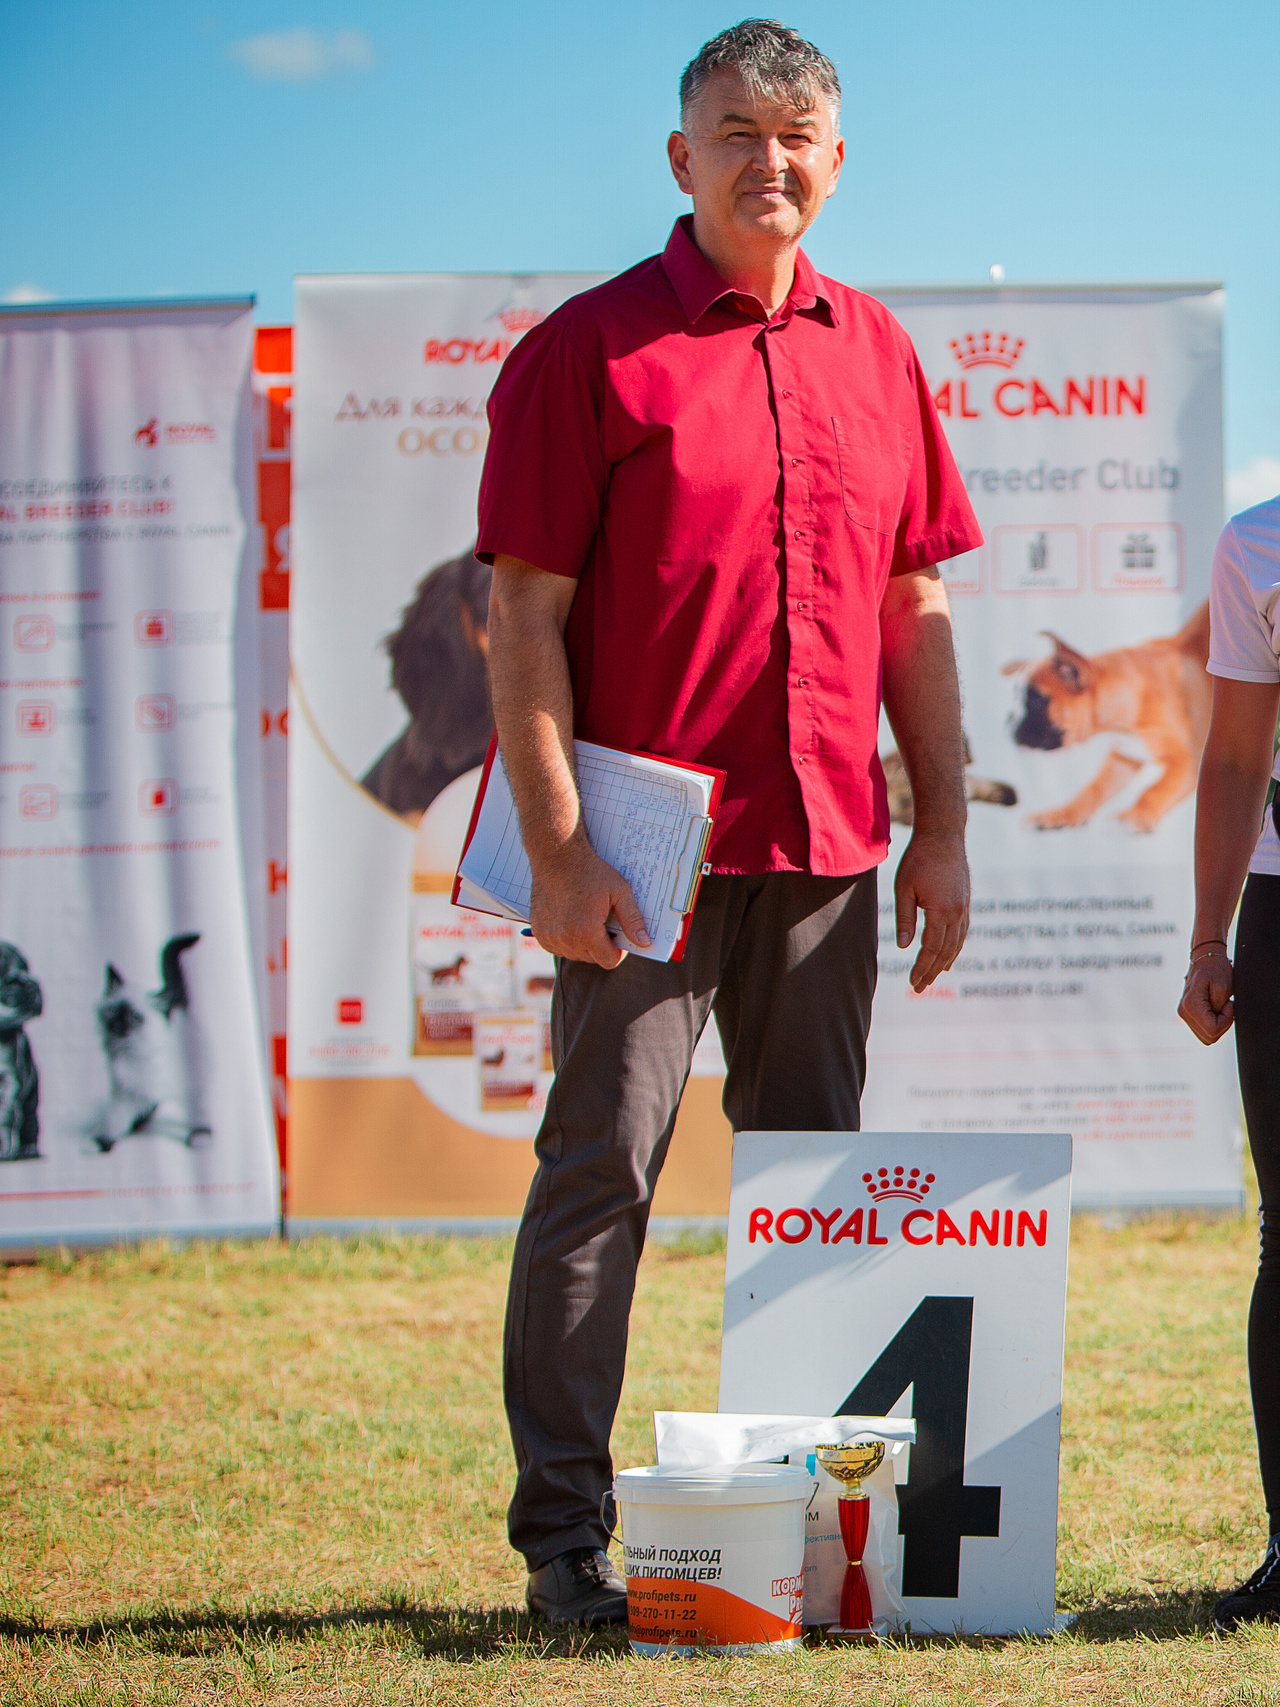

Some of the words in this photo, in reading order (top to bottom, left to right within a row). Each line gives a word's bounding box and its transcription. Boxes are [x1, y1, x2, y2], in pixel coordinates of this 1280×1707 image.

[335, 391, 401, 423] Для
[993, 376, 1146, 418] CANIN
[960, 459, 1087, 493] reeder
[1097, 458, 1180, 491] Club
[748, 1207, 888, 1245] ROYAL
[901, 1208, 1048, 1247] CANIN
[832, 1296, 1001, 1598] 4
[658, 1548, 722, 1564] ПОДХОД
[642, 1566, 722, 1582] ПИТОМЦЕВ!
